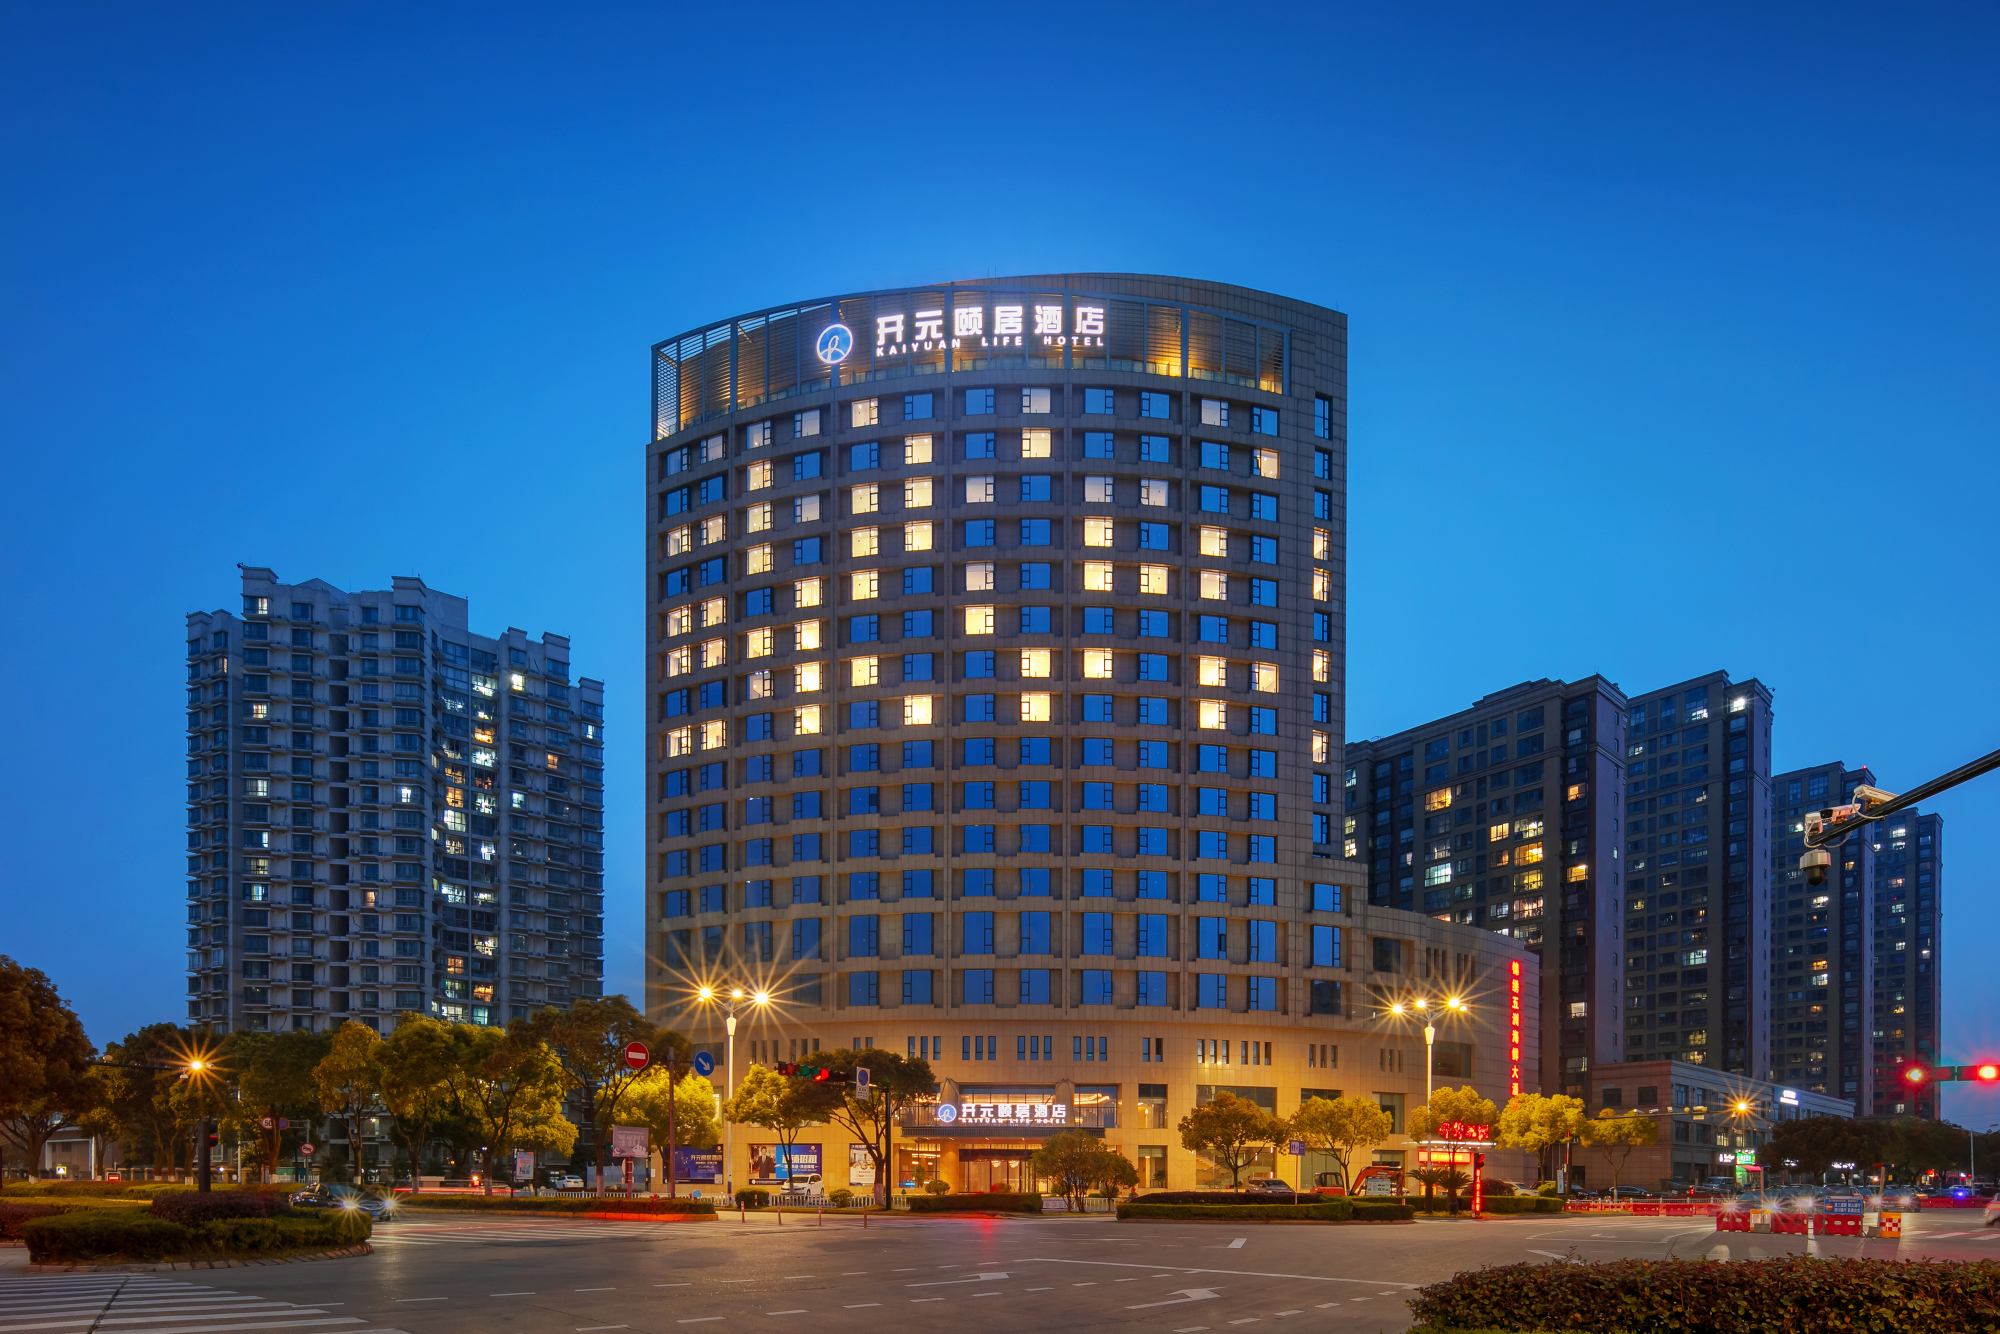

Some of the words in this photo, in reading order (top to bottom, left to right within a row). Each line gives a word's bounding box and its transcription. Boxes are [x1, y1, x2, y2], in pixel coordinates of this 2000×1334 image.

[876, 305, 1104, 346] 开元颐居酒店
[876, 338, 961, 357] KAIYUAN
[981, 336, 1023, 346] LIFE
[1043, 336, 1104, 346] HOTEL
[961, 1103, 1067, 1118] 开元颐居酒店
